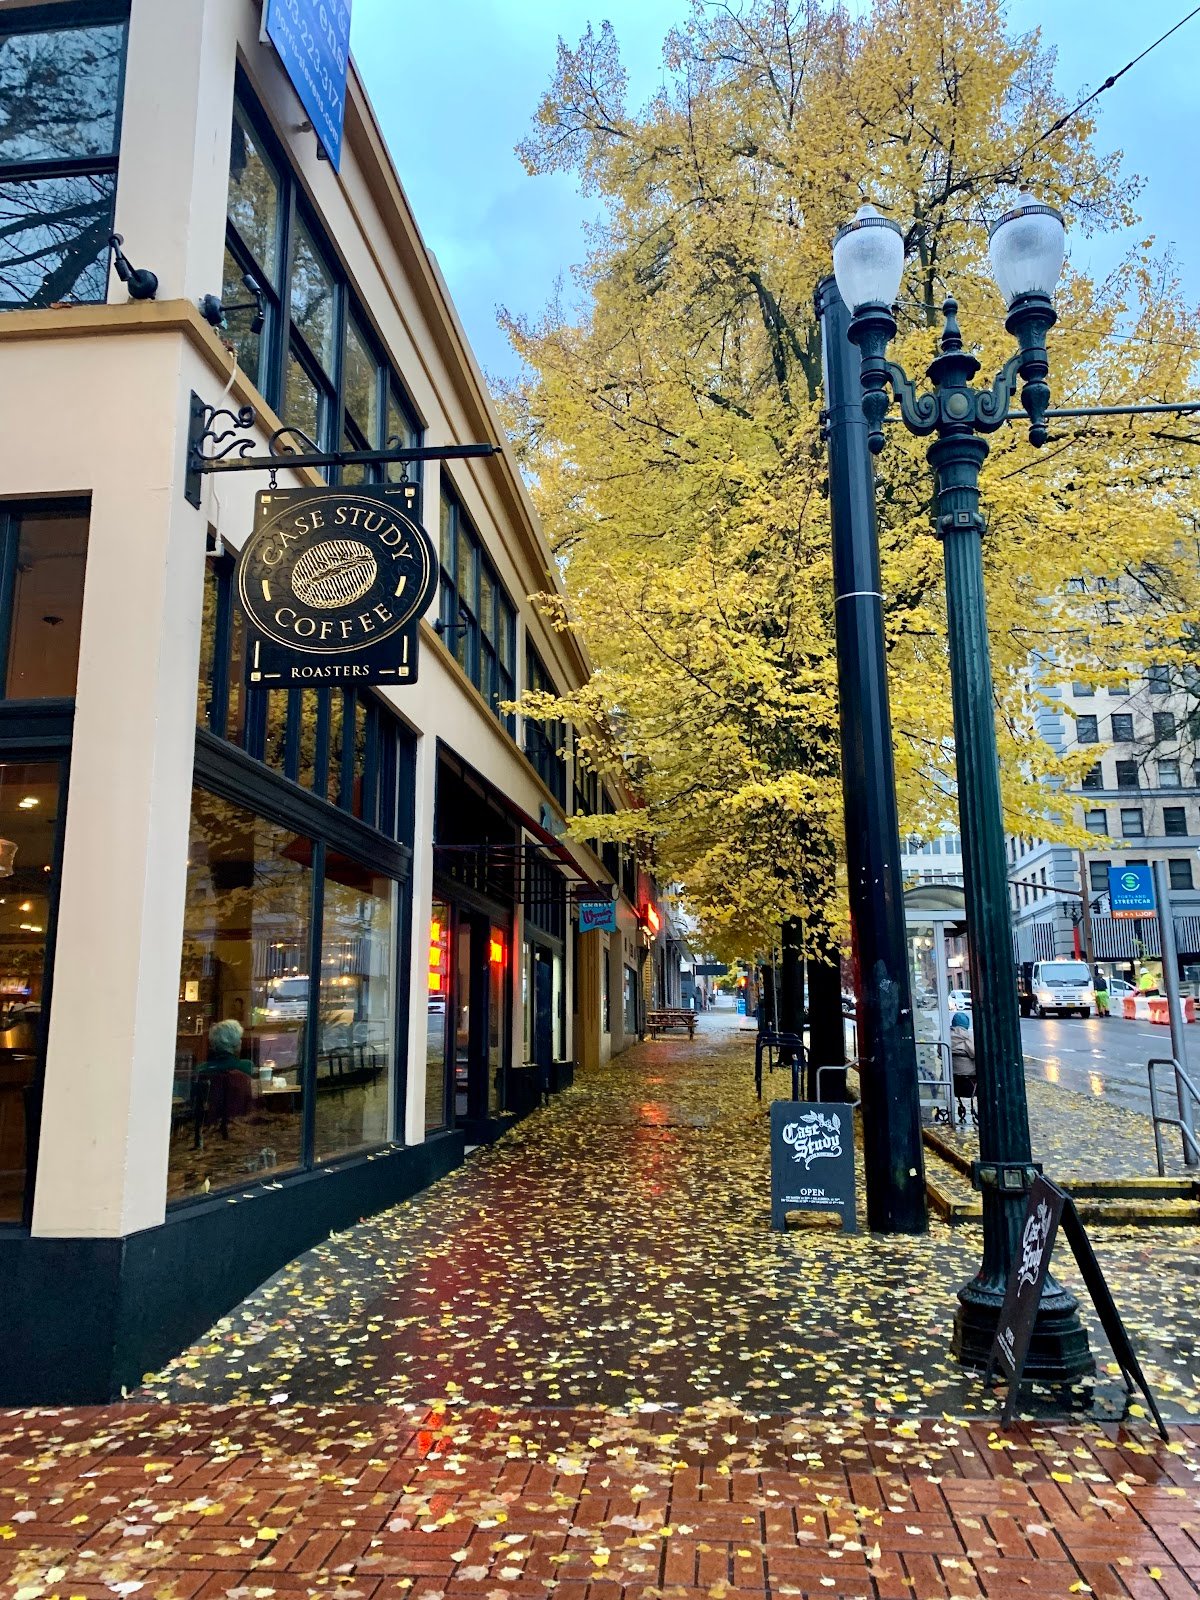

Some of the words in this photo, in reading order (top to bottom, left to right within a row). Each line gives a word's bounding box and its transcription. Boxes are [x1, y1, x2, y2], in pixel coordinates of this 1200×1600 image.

[313, 0, 345, 75] ens
[263, 510, 325, 565] CASE
[334, 506, 413, 561] STUDY
[275, 603, 392, 640] COFFEE
[291, 664, 370, 678] ROASTERS
[782, 1122, 821, 1145] Case
[792, 1131, 842, 1163] Study
[800, 1188, 825, 1196] OPEN
